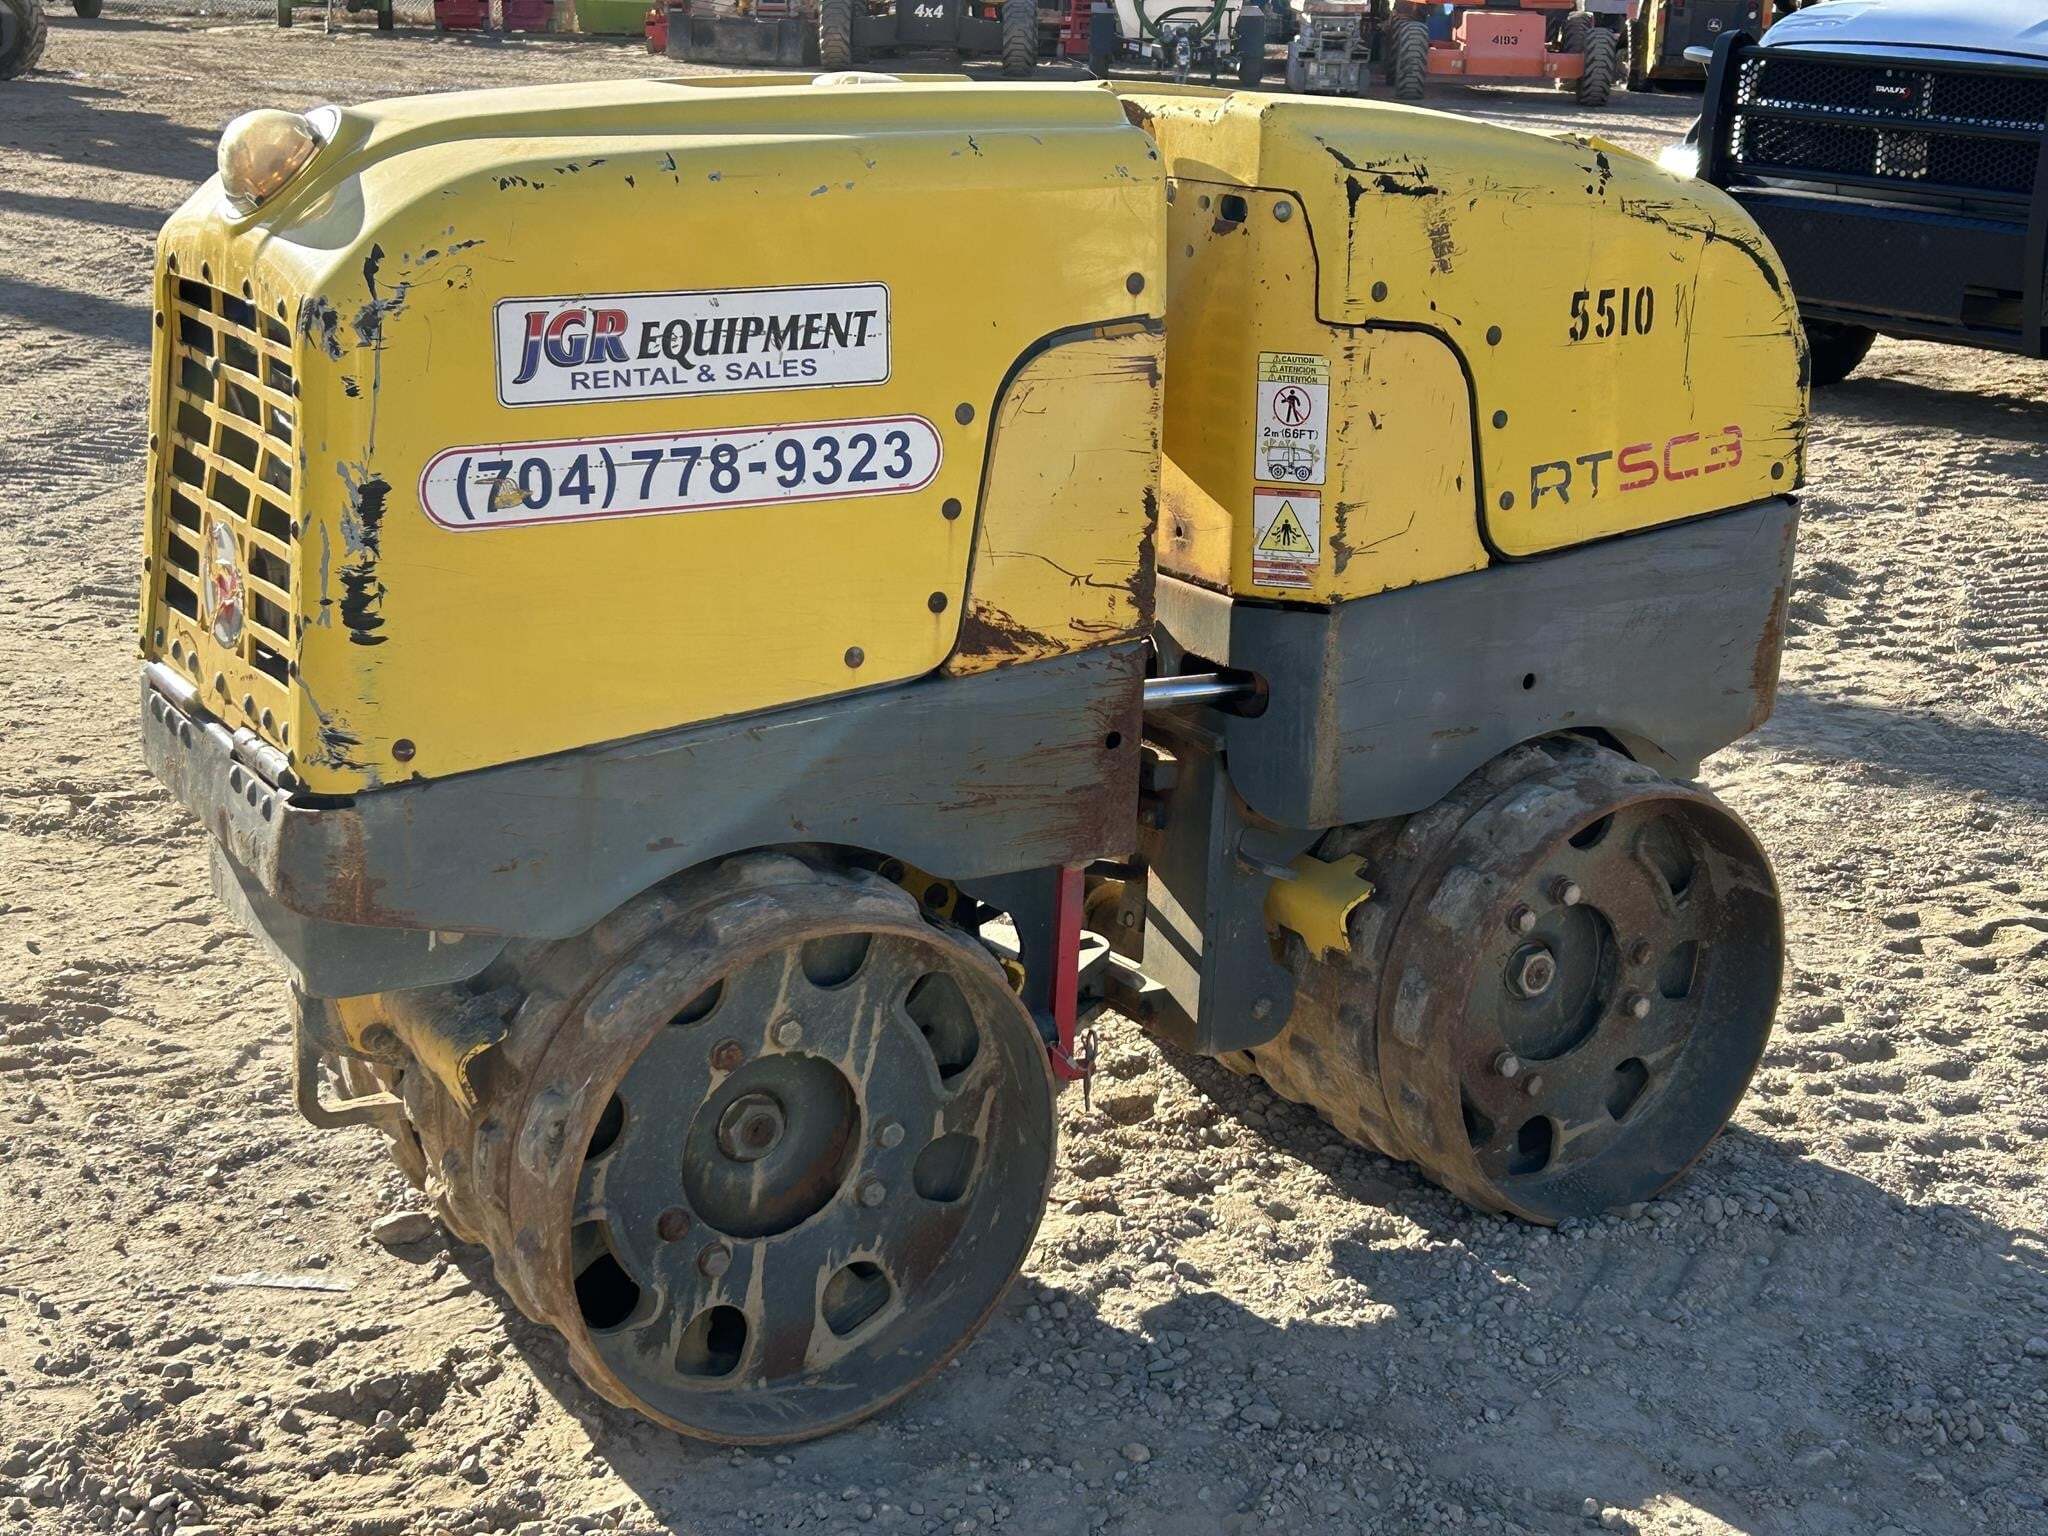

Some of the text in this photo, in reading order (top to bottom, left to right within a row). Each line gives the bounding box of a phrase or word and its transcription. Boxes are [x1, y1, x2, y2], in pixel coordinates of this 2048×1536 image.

[914, 3, 944, 18] 4x4
[1569, 286, 1654, 341] 5510
[512, 308, 878, 384] JGR EQUIPMENT
[1281, 355, 1315, 364] CAUTION
[570, 358, 818, 390] RENTAL & SALES
